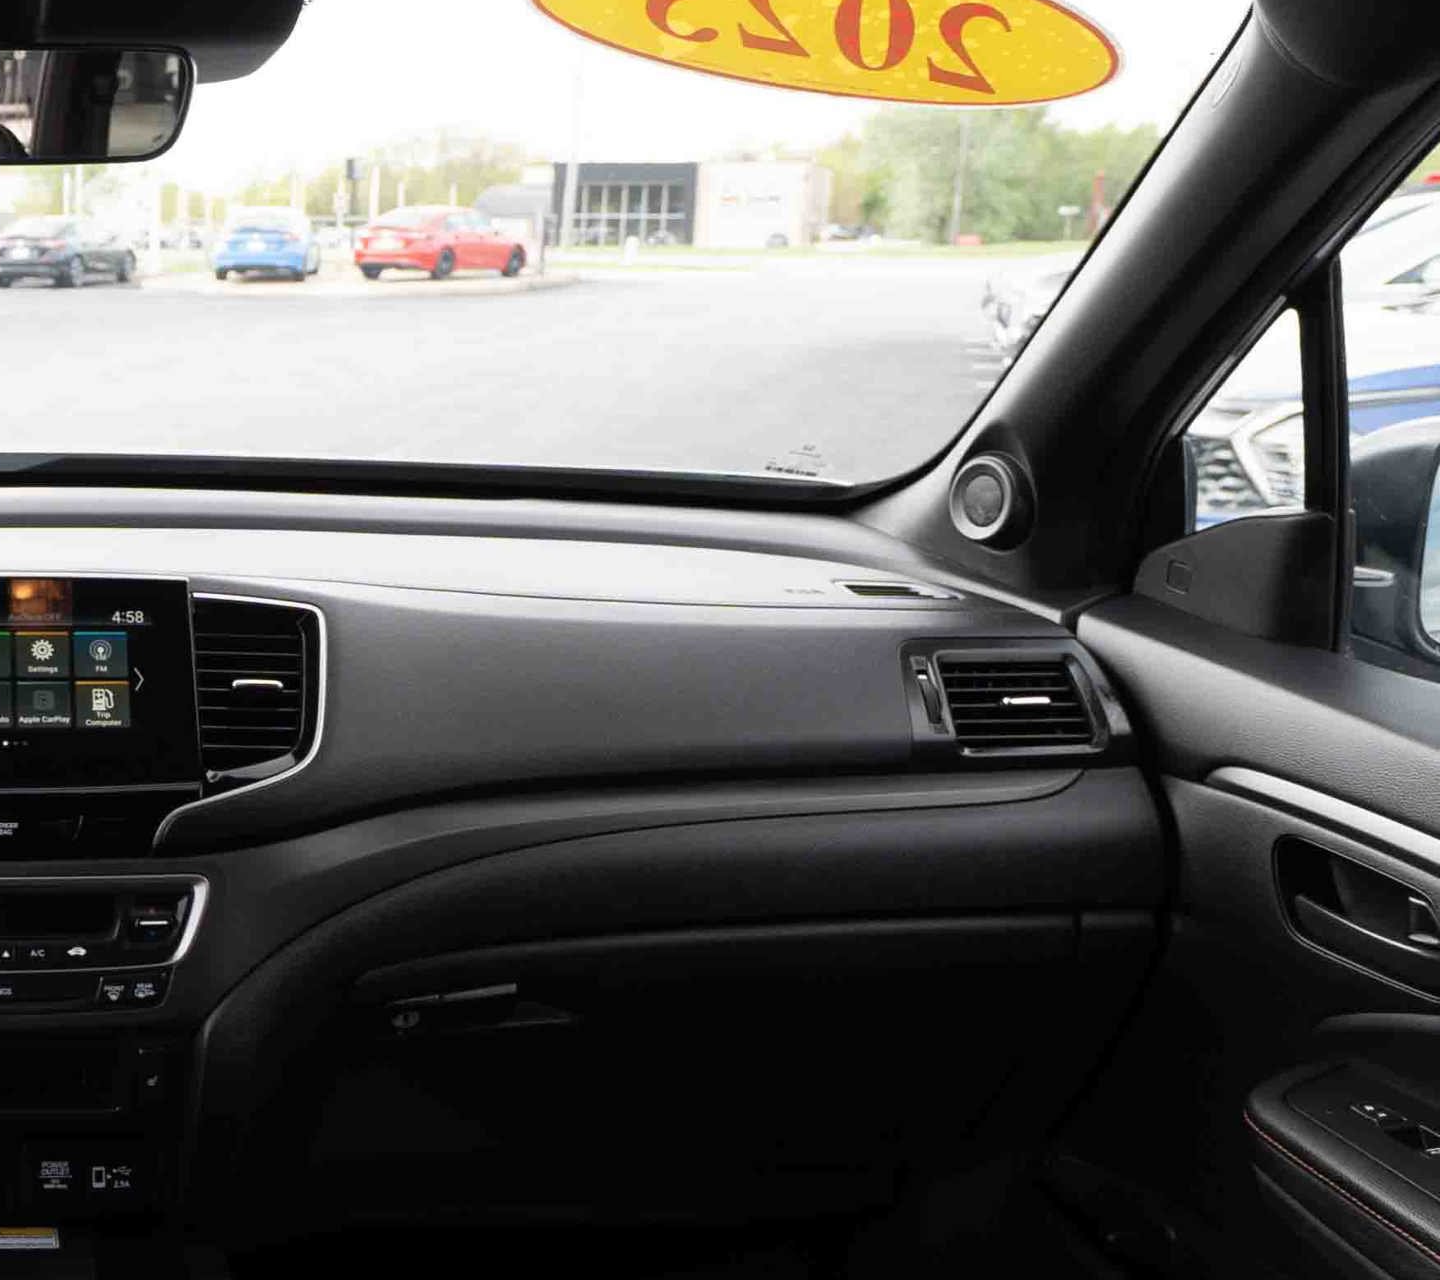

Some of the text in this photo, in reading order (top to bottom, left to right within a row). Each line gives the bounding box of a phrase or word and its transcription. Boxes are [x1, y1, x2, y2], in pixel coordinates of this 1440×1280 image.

[111, 610, 145, 624] 4:58
[27, 665, 59, 675] Settings
[95, 665, 108, 673] FM
[18, 715, 71, 725] Apple CarPlay
[85, 719, 122, 727] Computer
[29, 948, 47, 958] A/C
